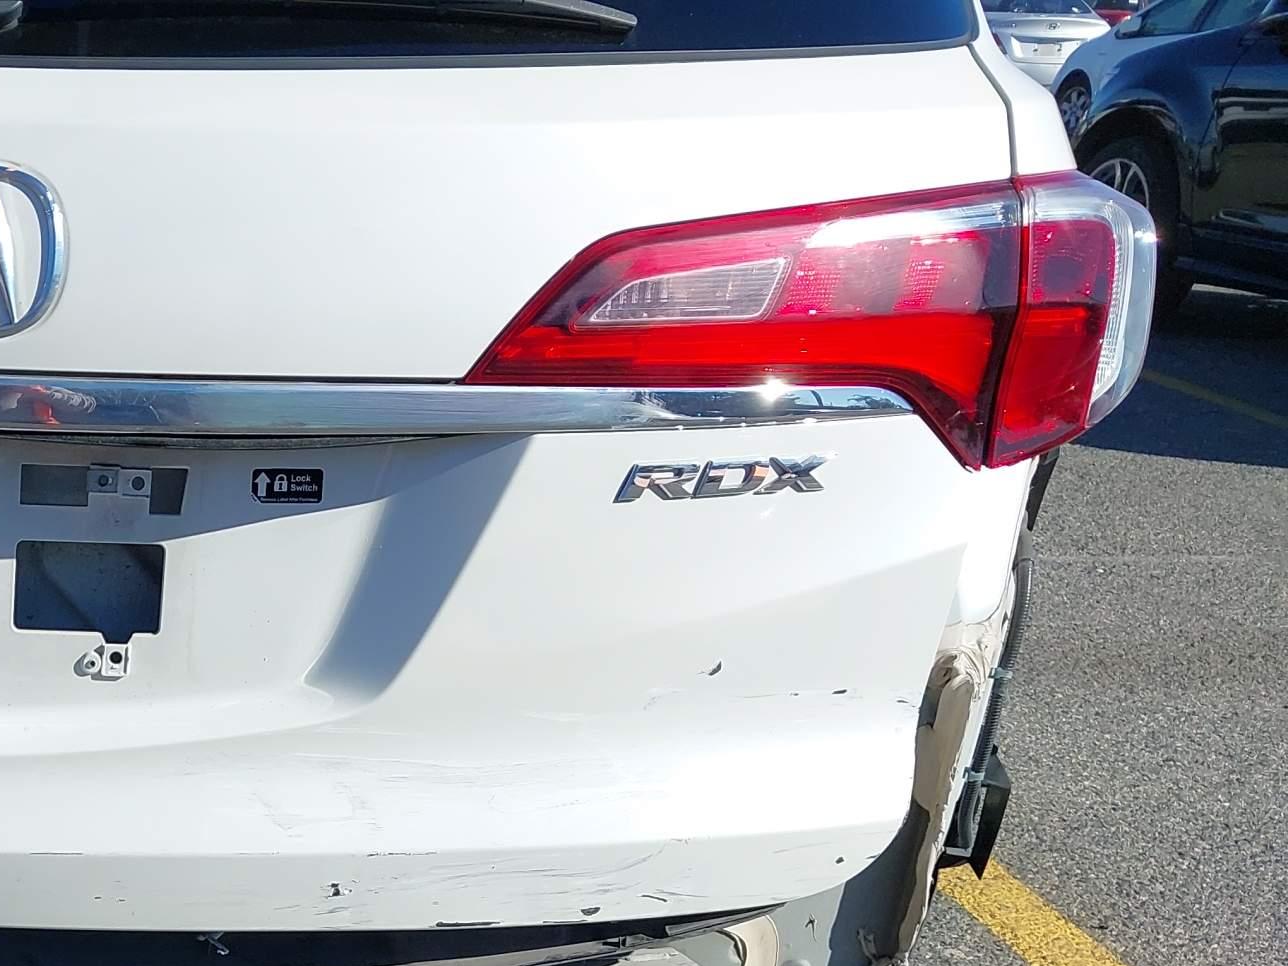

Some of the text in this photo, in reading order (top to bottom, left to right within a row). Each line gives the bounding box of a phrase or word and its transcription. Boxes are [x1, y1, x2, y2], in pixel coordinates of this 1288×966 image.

[291, 474, 311, 482] Lock
[612, 455, 827, 503] RDX
[291, 484, 318, 492] Switch
